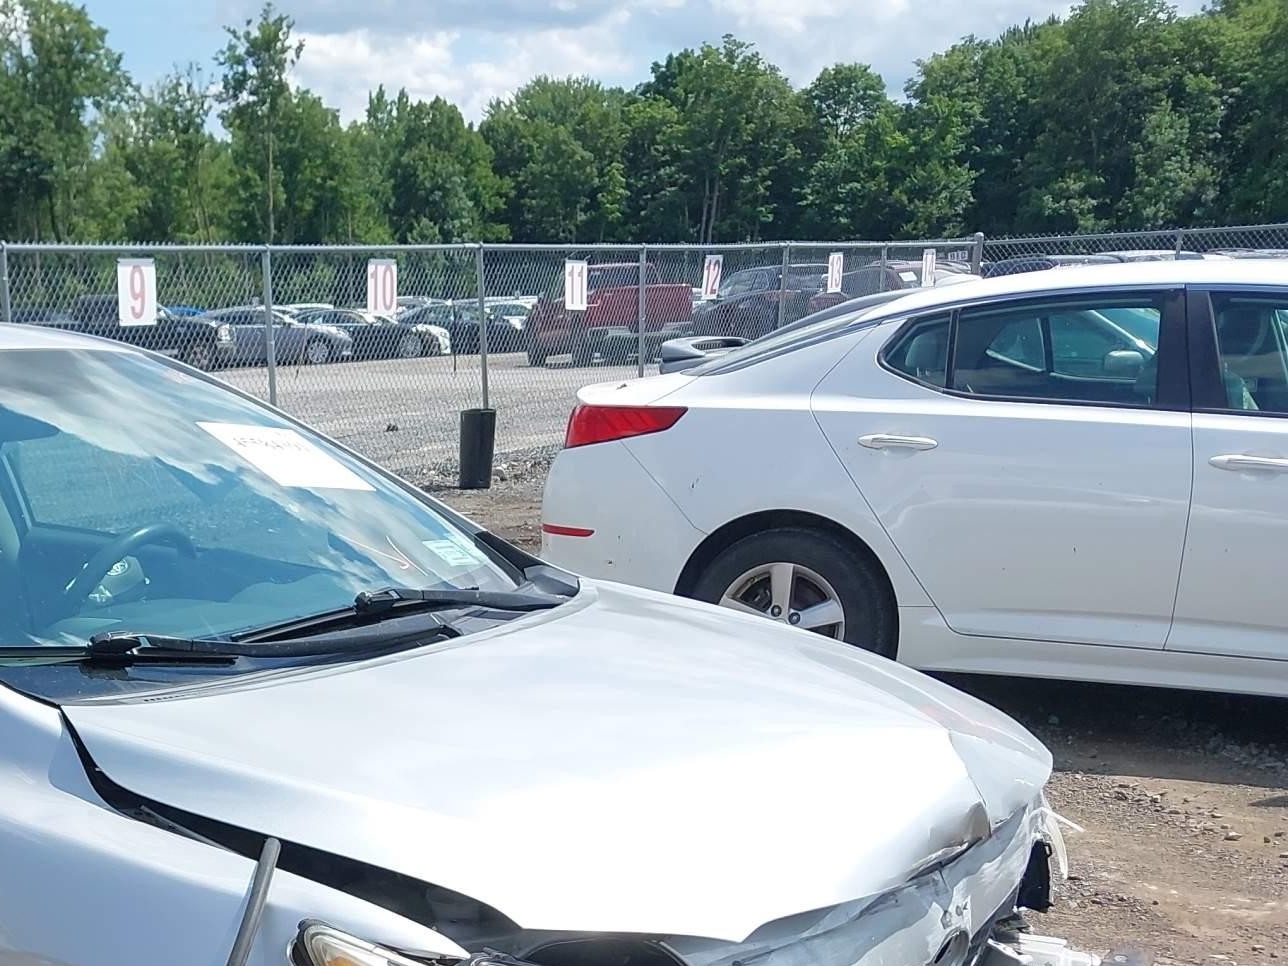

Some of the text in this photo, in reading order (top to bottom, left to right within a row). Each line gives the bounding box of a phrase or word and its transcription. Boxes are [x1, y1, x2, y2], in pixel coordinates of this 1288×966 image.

[370, 264, 394, 311] 10
[568, 265, 584, 305] 11
[704, 259, 721, 296] 12
[830, 255, 842, 288] 13
[130, 265, 146, 319] 9
